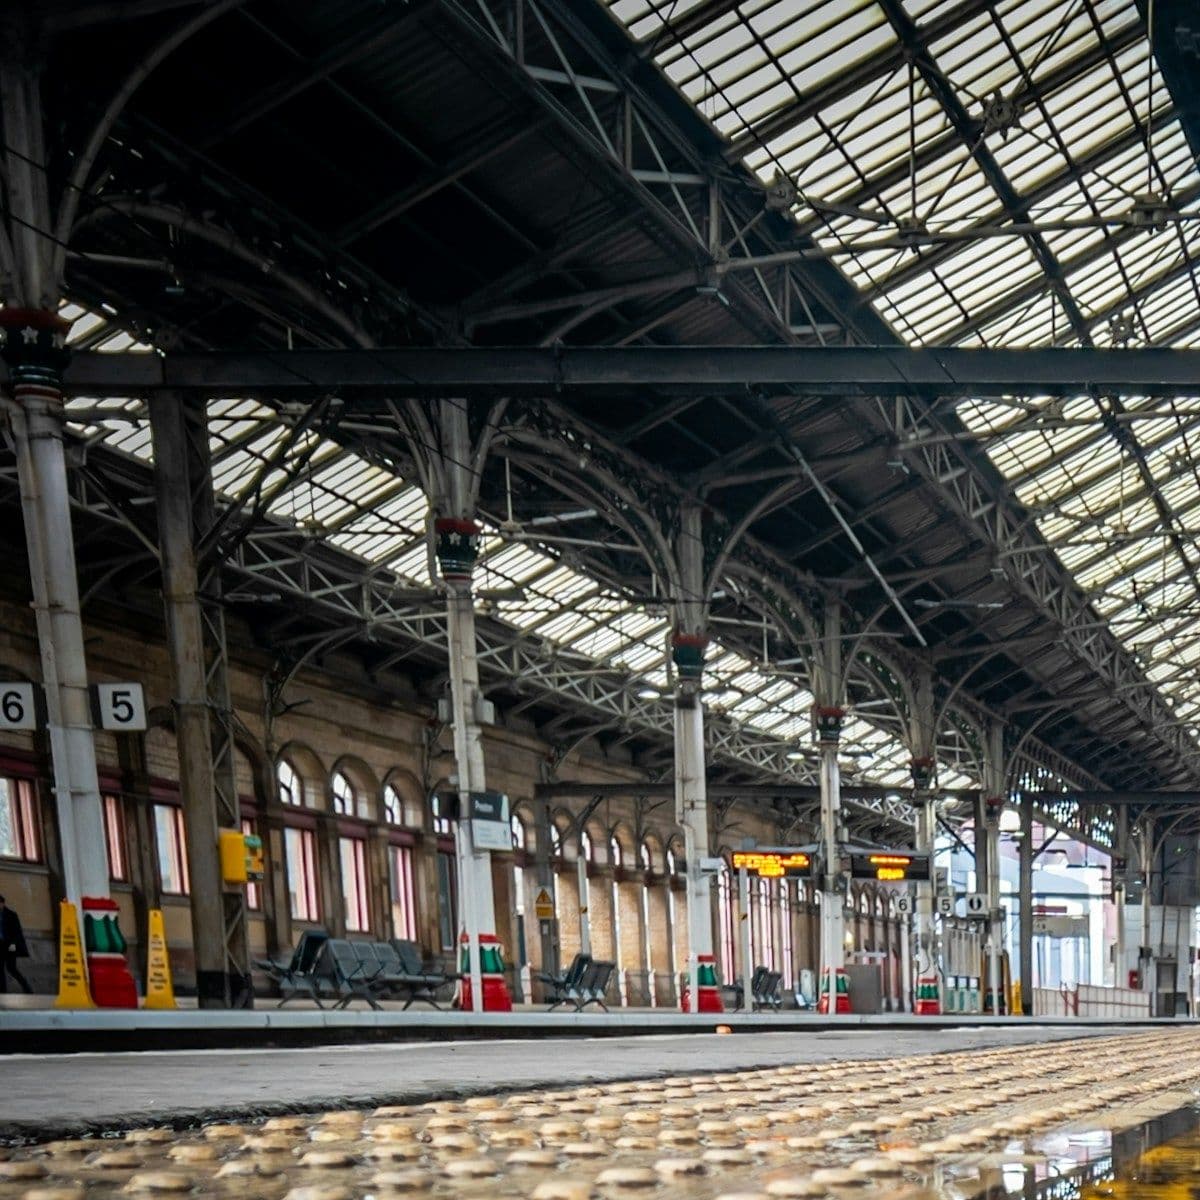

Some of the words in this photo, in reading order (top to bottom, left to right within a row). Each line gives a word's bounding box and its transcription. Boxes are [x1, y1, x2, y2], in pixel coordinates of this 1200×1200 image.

[2, 691, 24, 723] 6
[112, 691, 134, 723] 5
[898, 898, 908, 911] 6
[941, 898, 951, 911] 5
